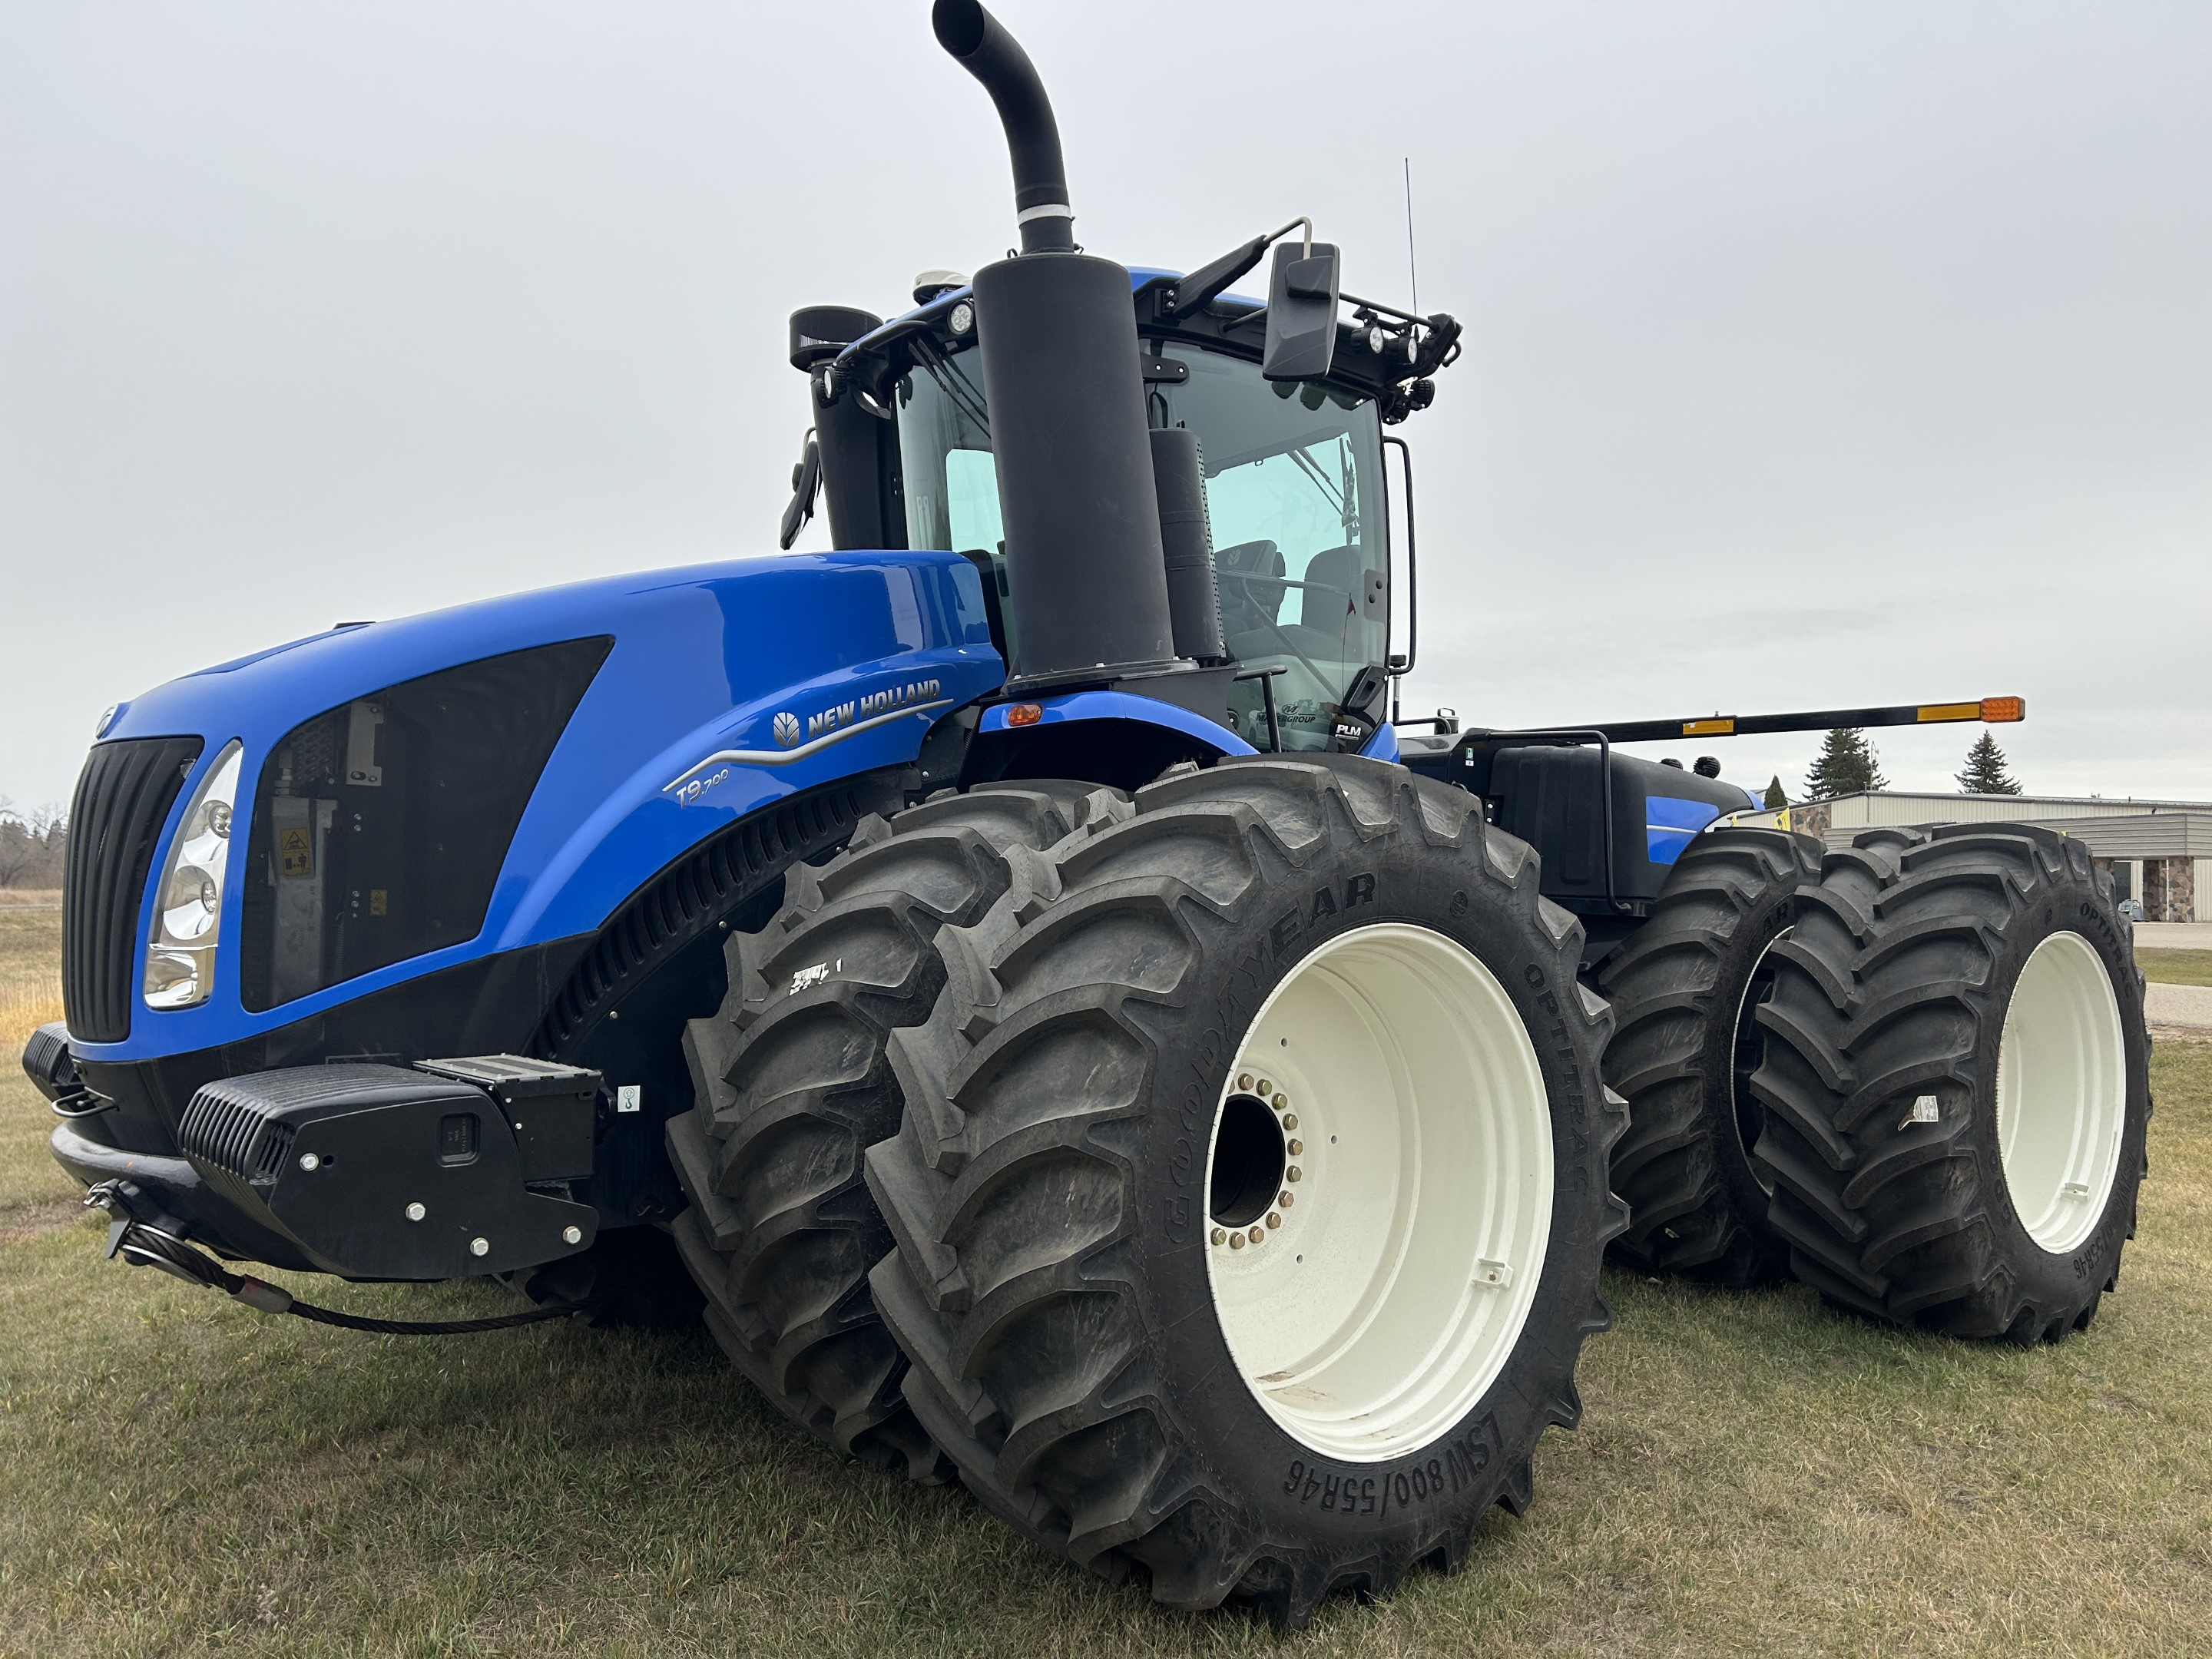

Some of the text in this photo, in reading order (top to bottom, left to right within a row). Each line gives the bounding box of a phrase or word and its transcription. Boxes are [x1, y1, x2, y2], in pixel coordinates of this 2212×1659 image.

[808, 679, 941, 739] NEW HOLLAND
[1256, 714, 1316, 724] MERGROUP
[1336, 724, 1362, 737] PLM
[676, 768, 729, 809] T9.700
[1524, 962, 1588, 1196] OPTITRAC
